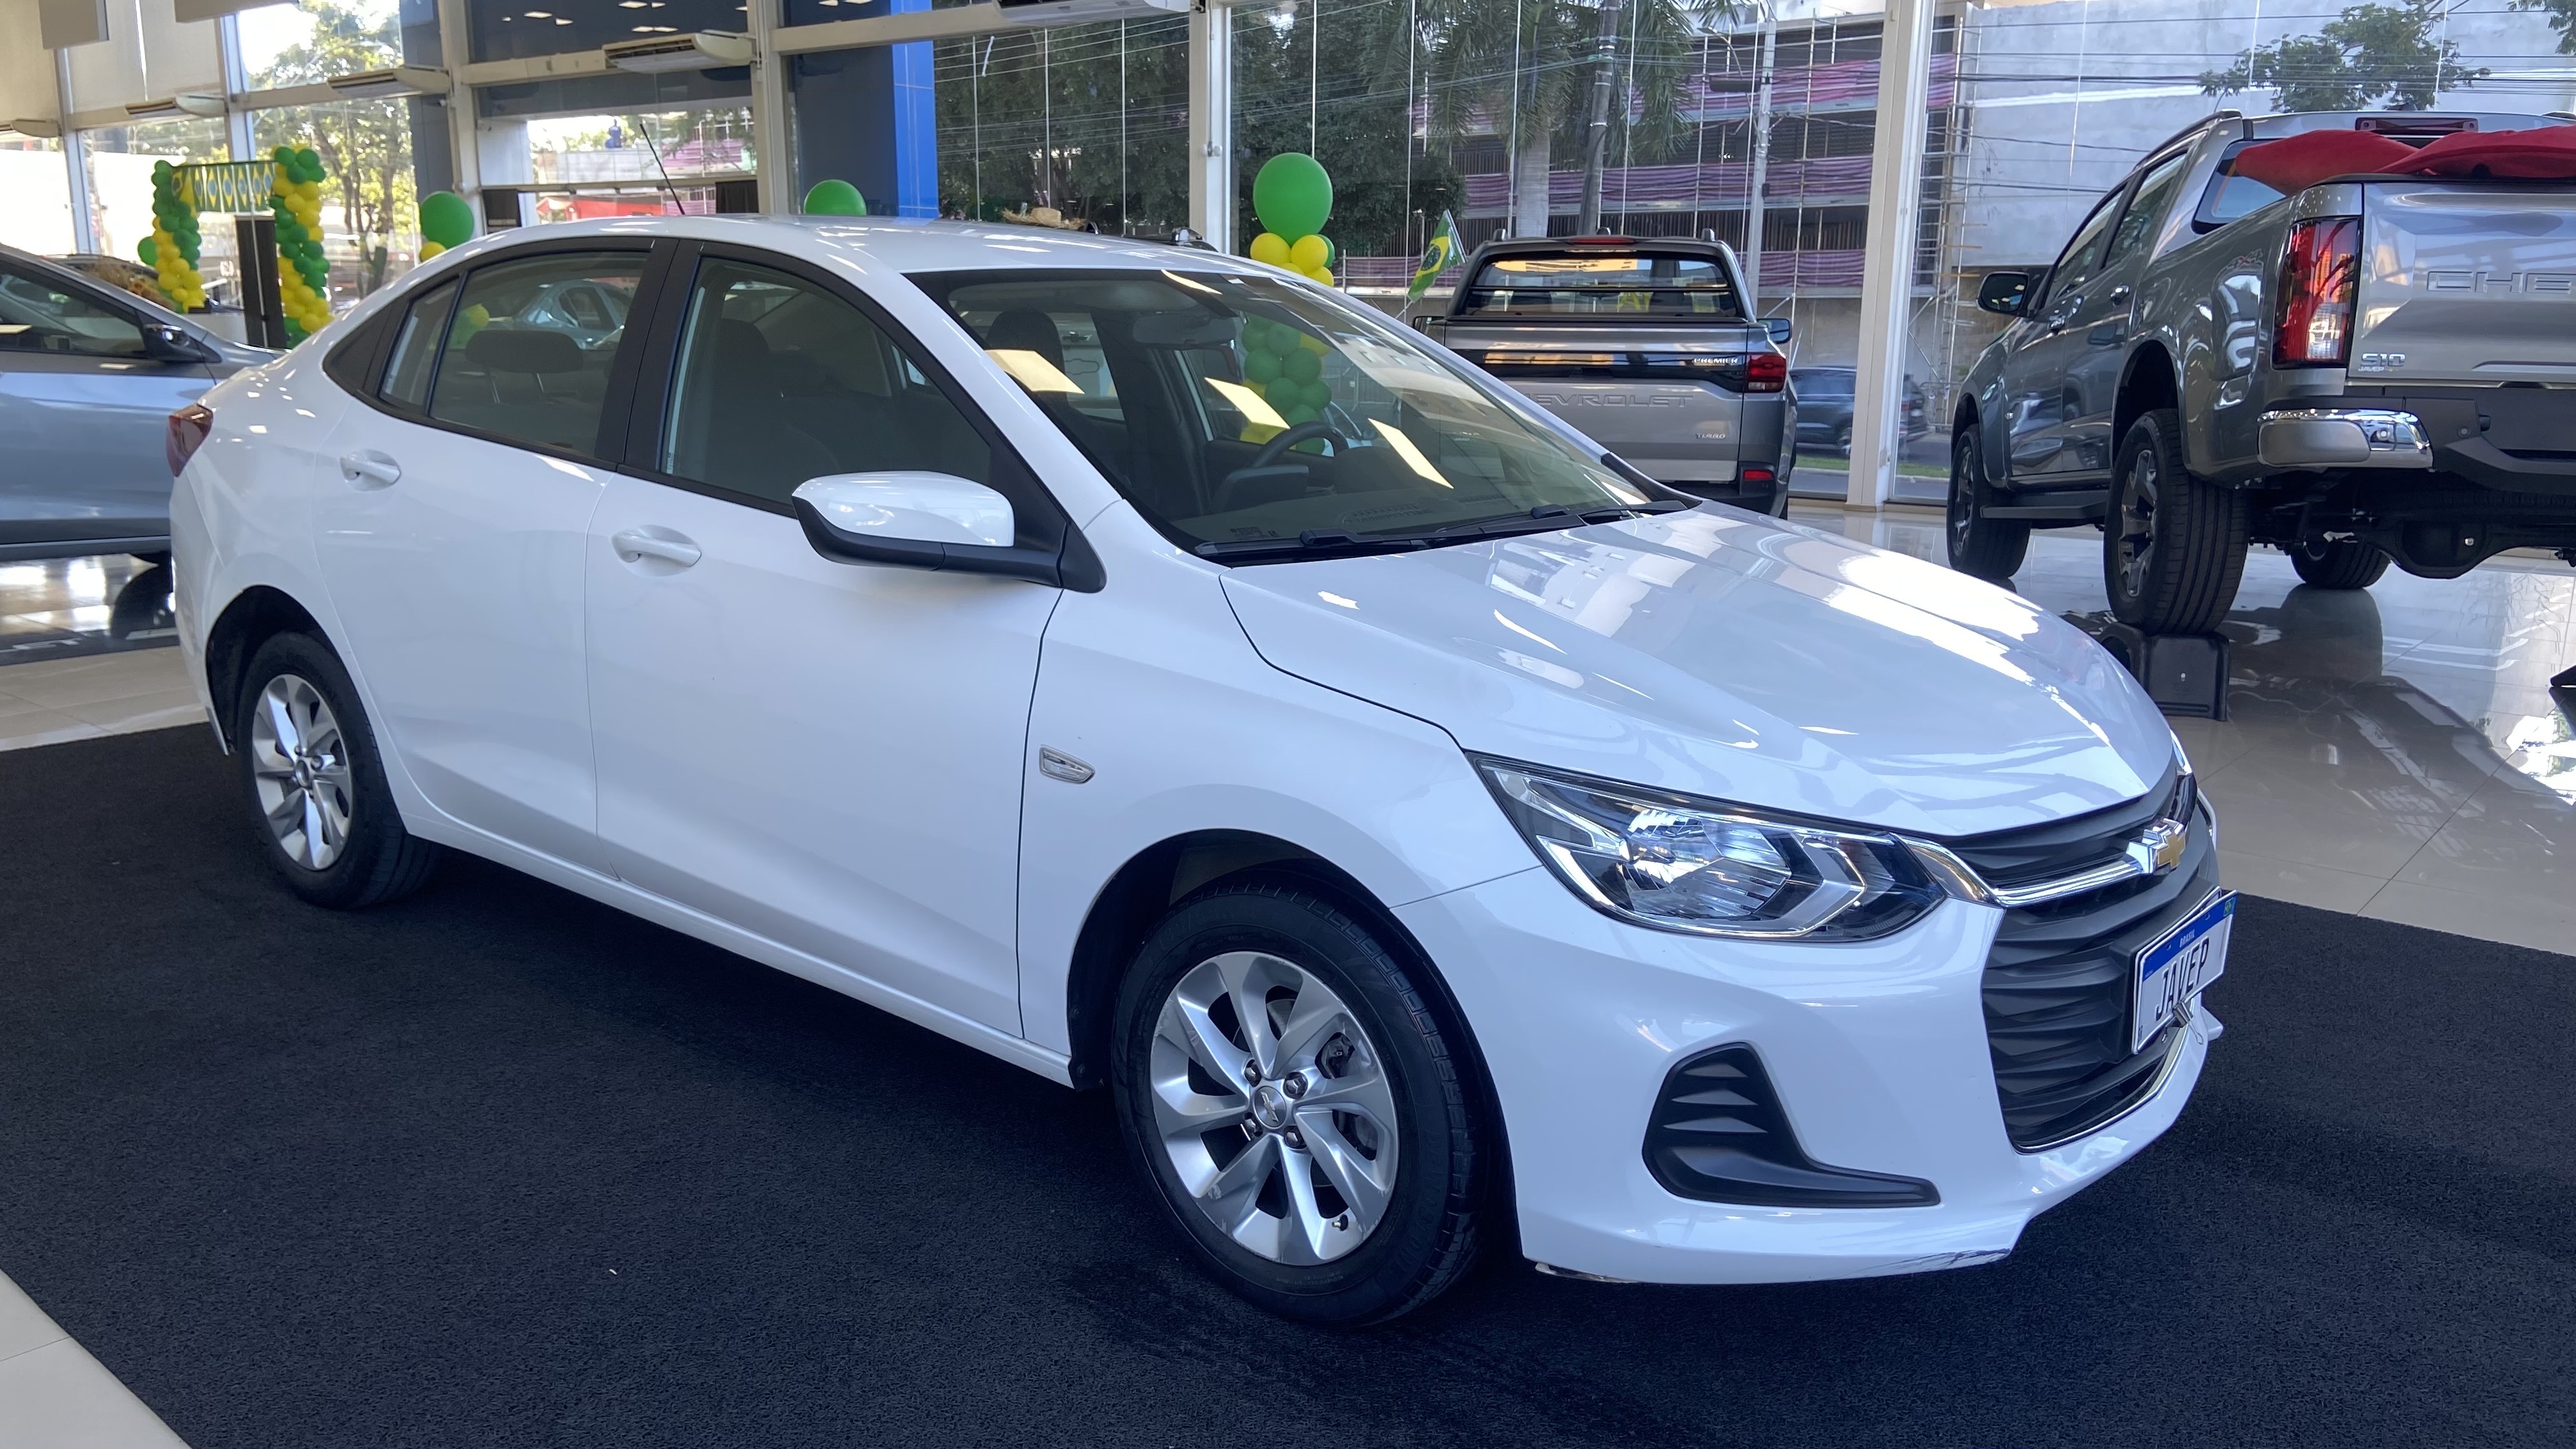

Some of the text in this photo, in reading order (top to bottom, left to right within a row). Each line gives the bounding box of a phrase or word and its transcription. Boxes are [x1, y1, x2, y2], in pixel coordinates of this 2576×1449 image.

[2361, 353, 2405, 366] S10
[2179, 929, 2195, 948] BRASIL
[2155, 935, 2210, 1022] JAVEP
